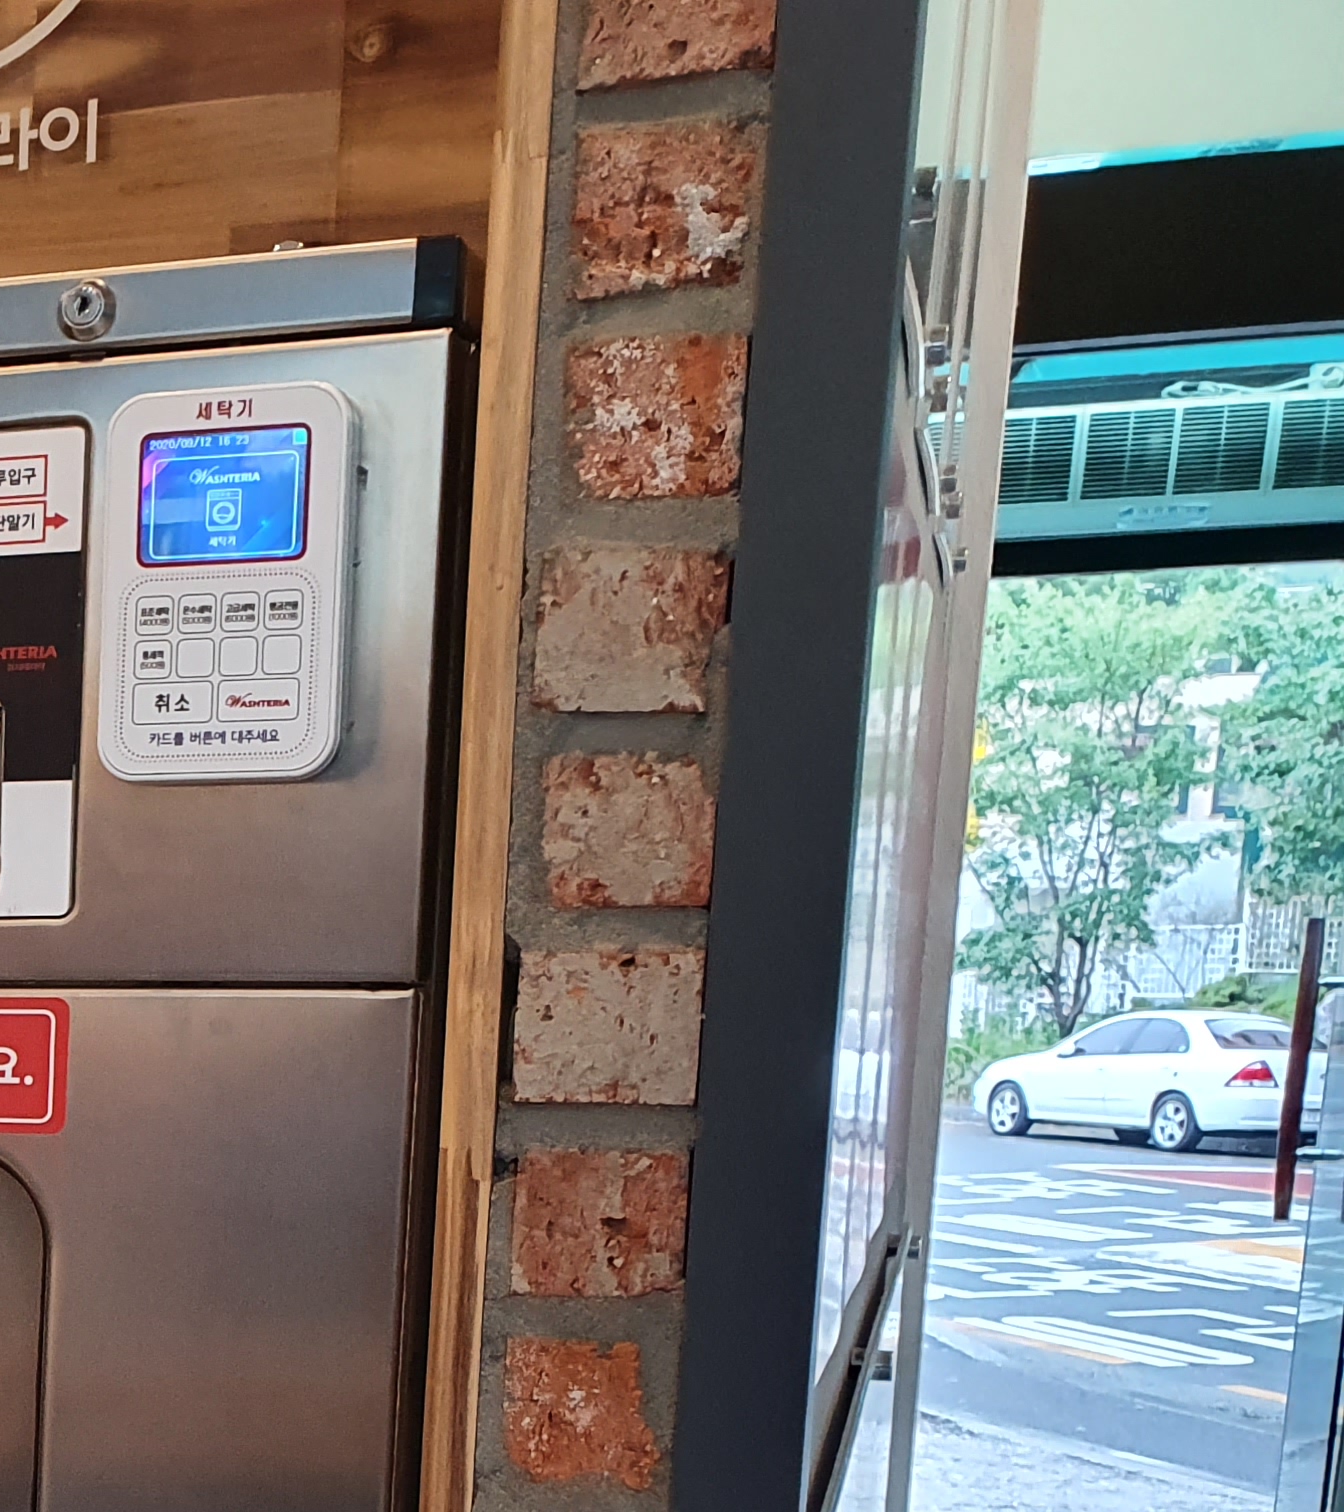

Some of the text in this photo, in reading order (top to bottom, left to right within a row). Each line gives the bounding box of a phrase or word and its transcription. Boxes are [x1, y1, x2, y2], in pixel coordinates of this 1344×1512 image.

[196, 398, 253, 420] 세탁기
[236, 436, 249, 445] 23
[189, 466, 260, 485] WASHTERIA
[155, 694, 190, 713] 취소
[149, 730, 279, 747] 카드를 버튼에 대주세요
